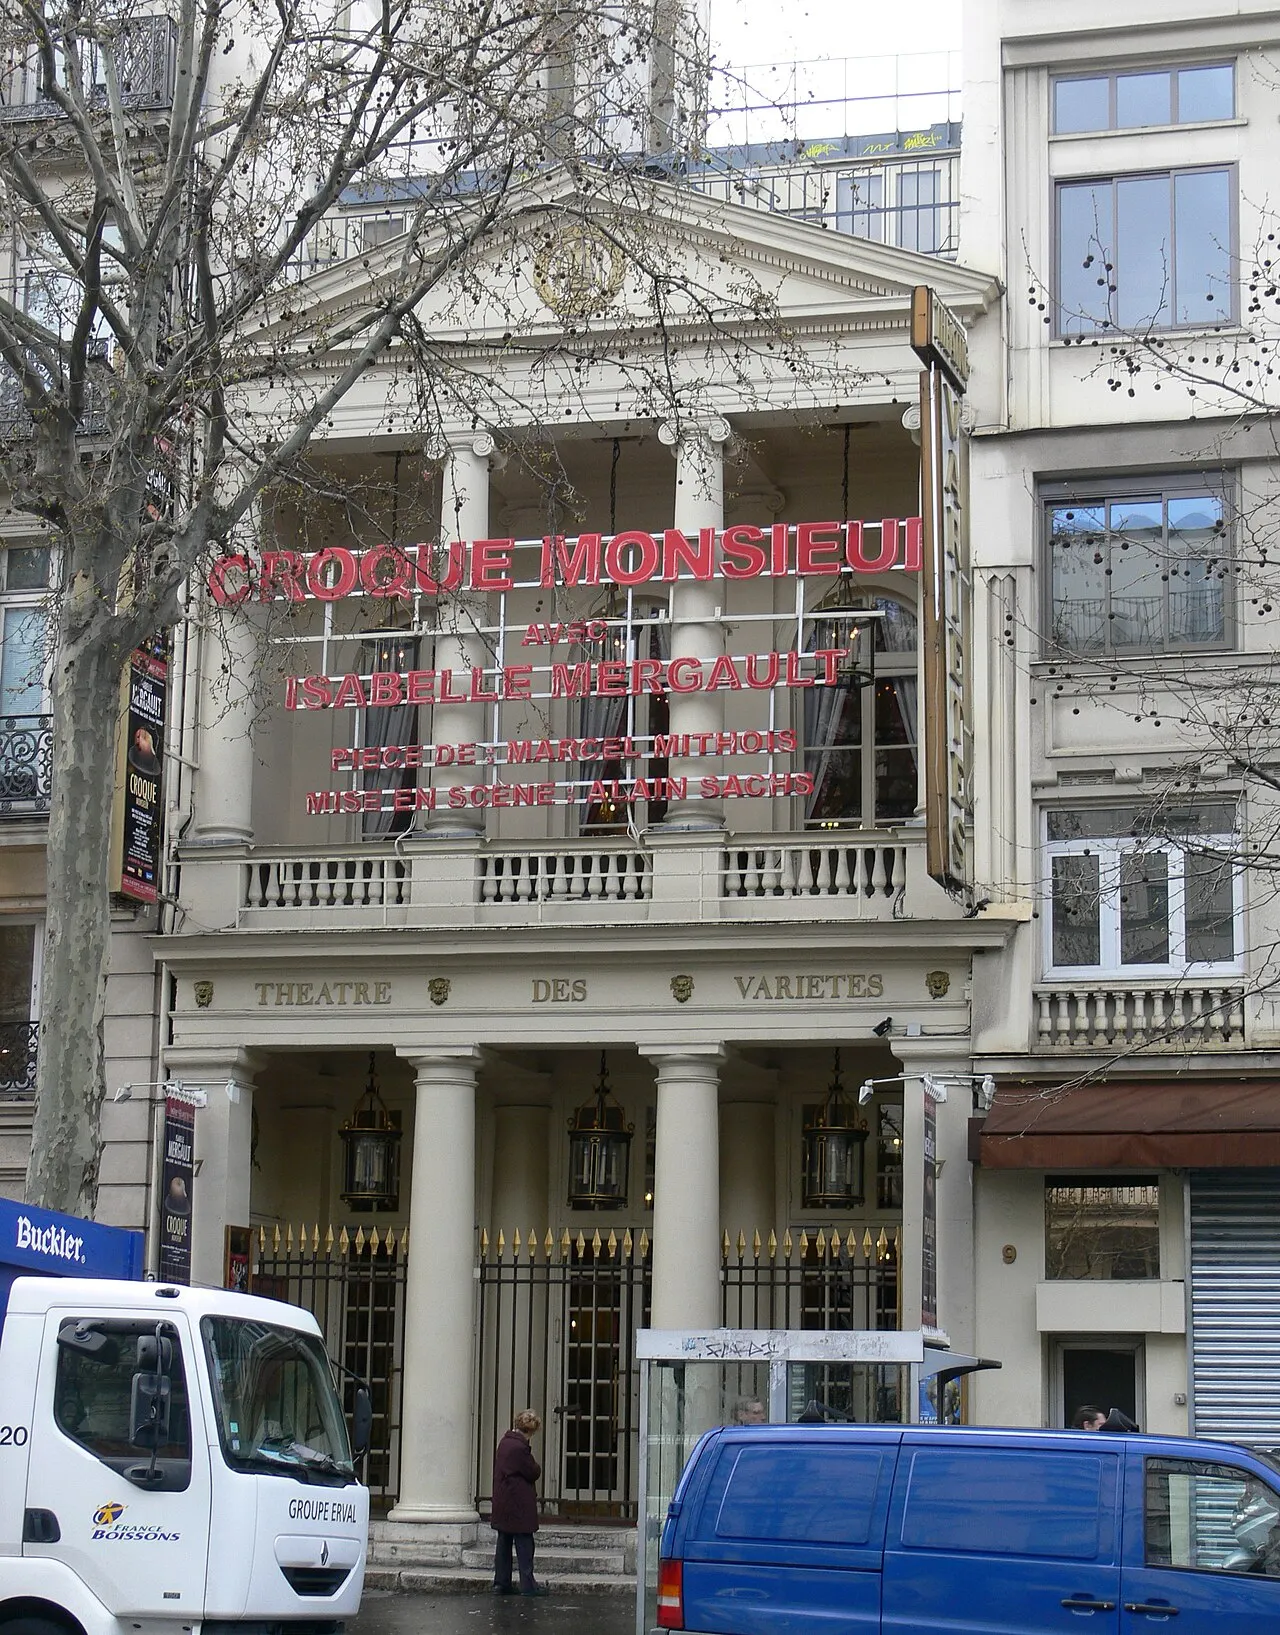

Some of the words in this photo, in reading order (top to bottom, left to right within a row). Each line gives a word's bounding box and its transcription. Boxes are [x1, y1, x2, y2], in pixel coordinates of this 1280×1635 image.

[208, 538, 515, 606] CROQUE
[520, 619, 608, 646] AVEC
[285, 665, 533, 711] ISABELLE
[552, 649, 848, 699] MERGAULT
[331, 745, 422, 771] PIECE
[507, 737, 640, 764] MARCEL
[654, 729, 798, 758] MITHOIS
[130, 773, 157, 804] CROQUE
[306, 790, 381, 814] MISE
[394, 787, 436, 811] EN
[588, 776, 687, 801] ALAIN
[701, 772, 815, 797] SACHS
[255, 982, 392, 1006] THEATRE
[531, 979, 587, 1002] DES
[734, 974, 884, 1000] VARIETES
[1002, 1245, 1016, 1264] 9
[289, 1499, 329, 1521] GROUPE
[331, 1503, 357, 1523] ERVAL
[91, 1530, 181, 1541] BOISSONS
[114, 1524, 164, 1532] FRANCE
